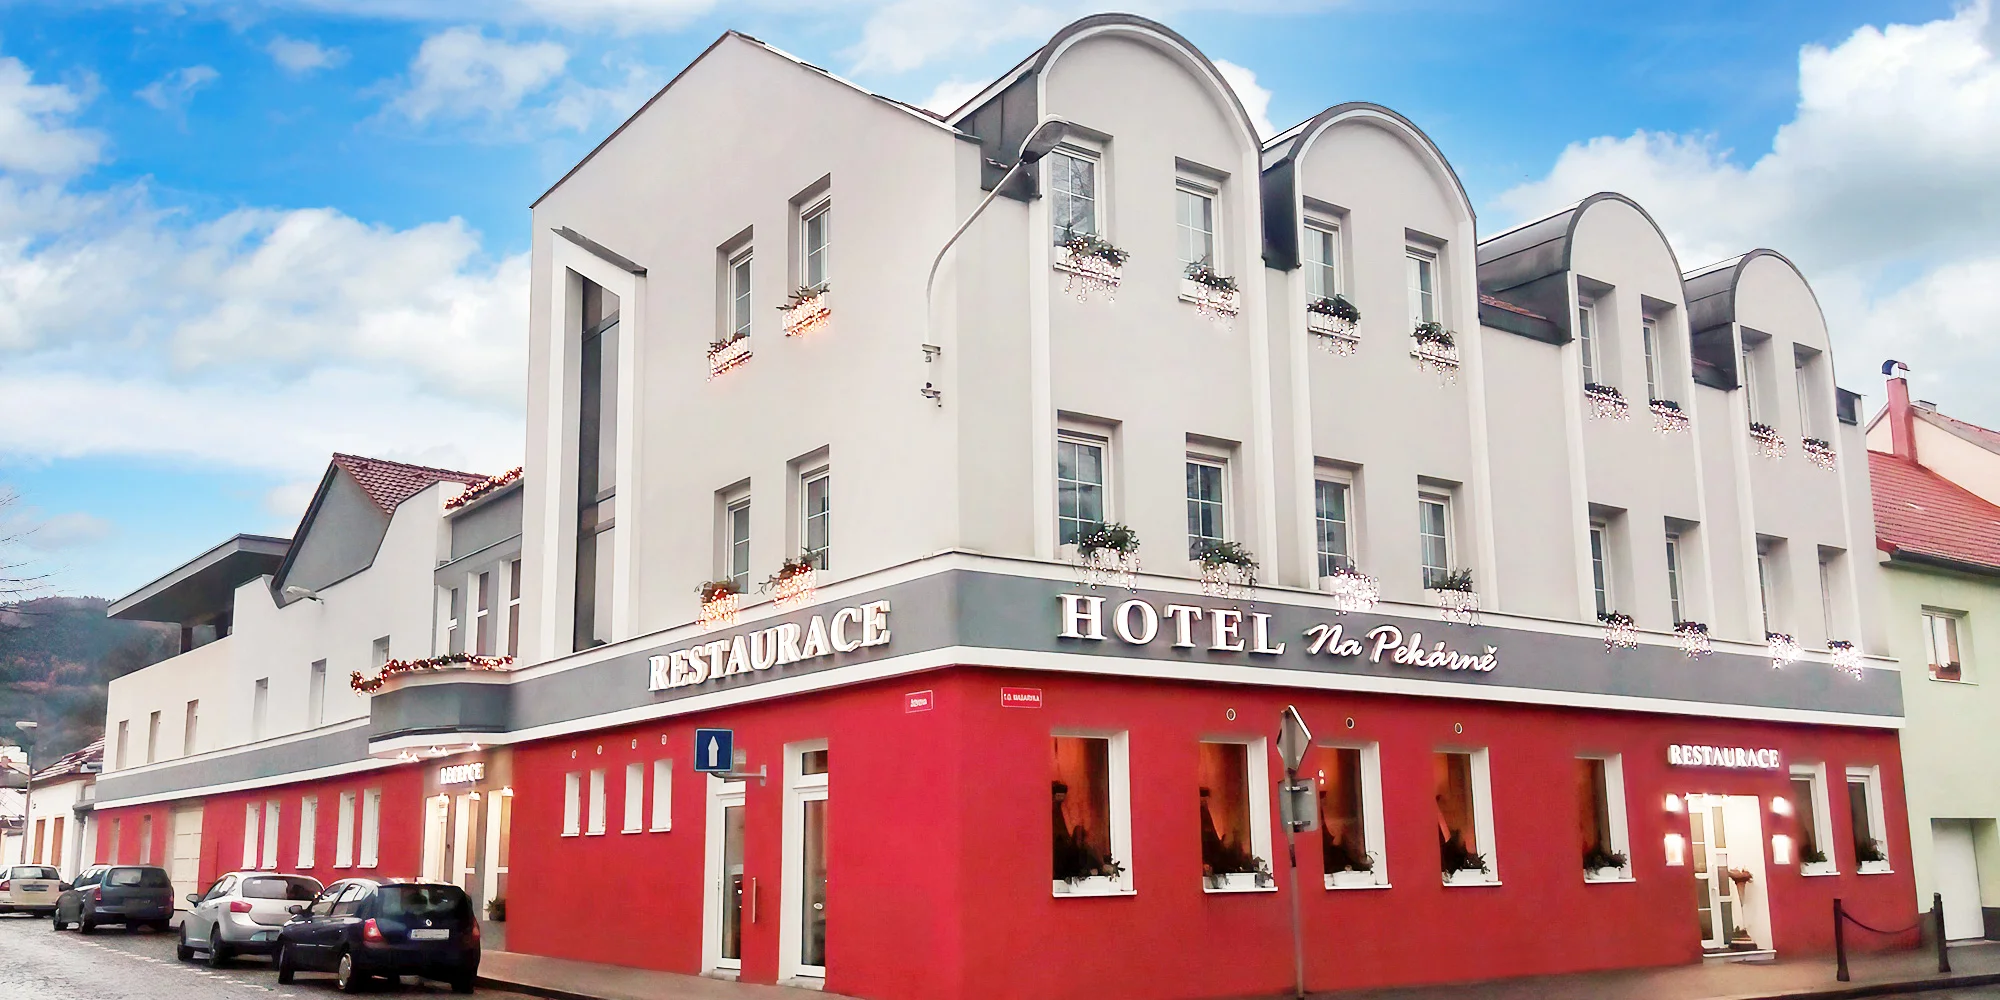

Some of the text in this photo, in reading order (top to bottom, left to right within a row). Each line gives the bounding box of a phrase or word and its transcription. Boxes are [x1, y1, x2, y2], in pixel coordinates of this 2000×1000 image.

[648, 600, 891, 692] RESTAURACE
[1056, 593, 1499, 672] HOTEL Na Pekárně
[1667, 744, 1780, 768] RESTAURACE
